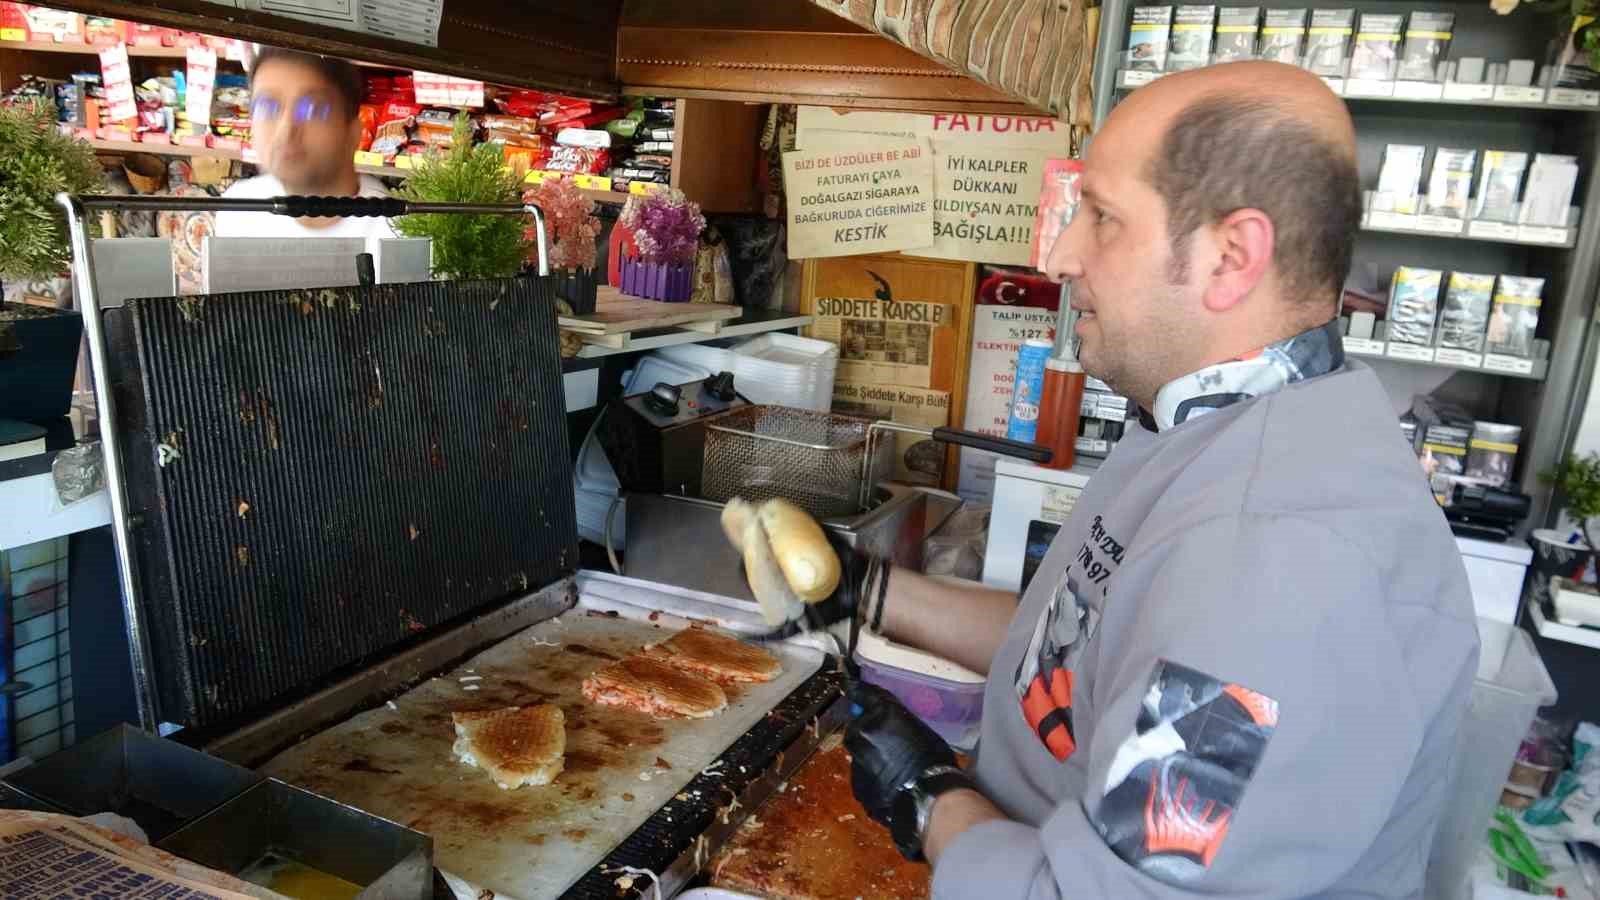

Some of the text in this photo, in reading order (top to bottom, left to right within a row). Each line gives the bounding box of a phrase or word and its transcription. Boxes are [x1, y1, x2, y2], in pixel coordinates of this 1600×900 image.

[932, 113, 1056, 133] FATURA
[817, 157, 832, 168] DE
[834, 152, 884, 167] ÜZDÜLER
[886, 150, 901, 161] BE
[947, 155, 1029, 174] İYİ KALPLER
[817, 172, 870, 187] FATURAYI
[953, 177, 1017, 195] DÜKKANI
[865, 185, 920, 201] SİGARAYA
[834, 222, 888, 244] KESTİK
[932, 219, 1031, 245] BAĞIŞLA!!!
